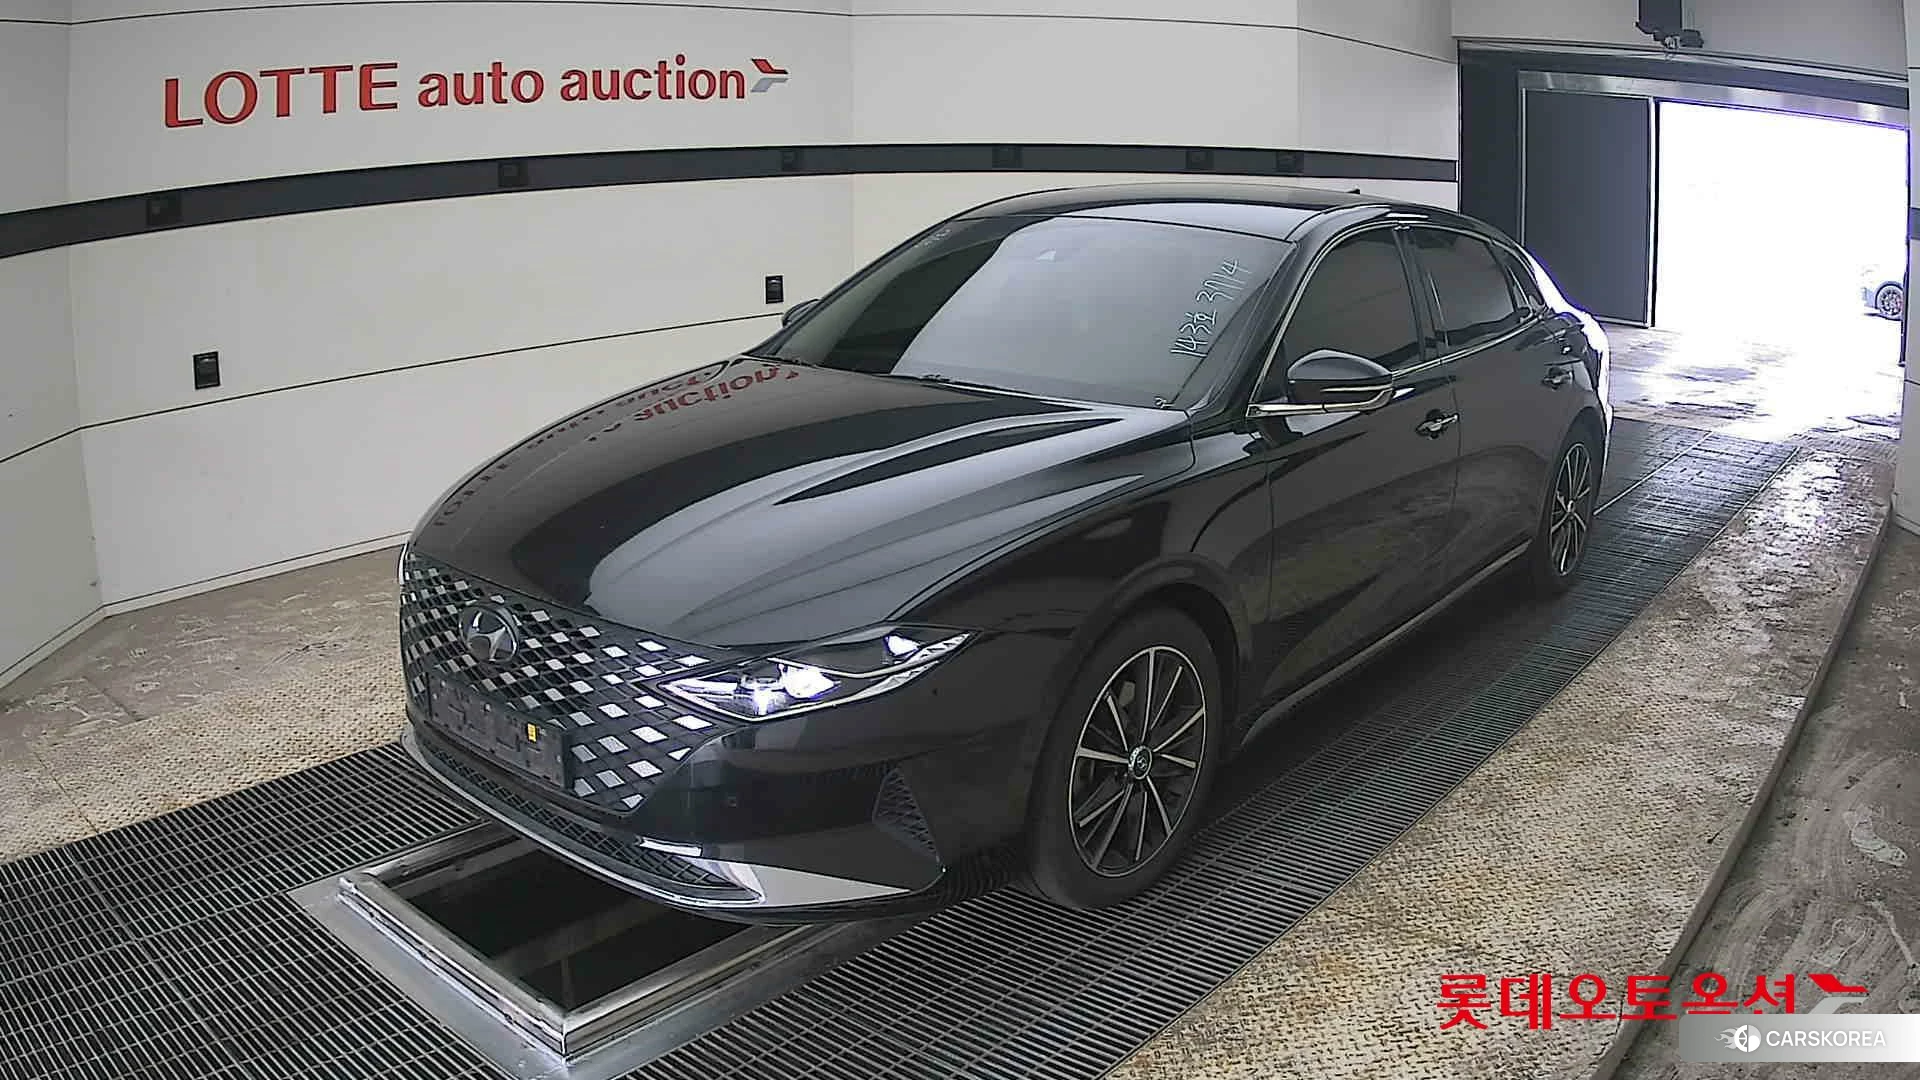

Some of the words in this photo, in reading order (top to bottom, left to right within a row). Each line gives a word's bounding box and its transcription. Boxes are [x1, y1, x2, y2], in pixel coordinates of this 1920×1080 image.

[164, 62, 399, 129] LOTTE
[417, 61, 545, 108] auto
[559, 54, 746, 102] auction
